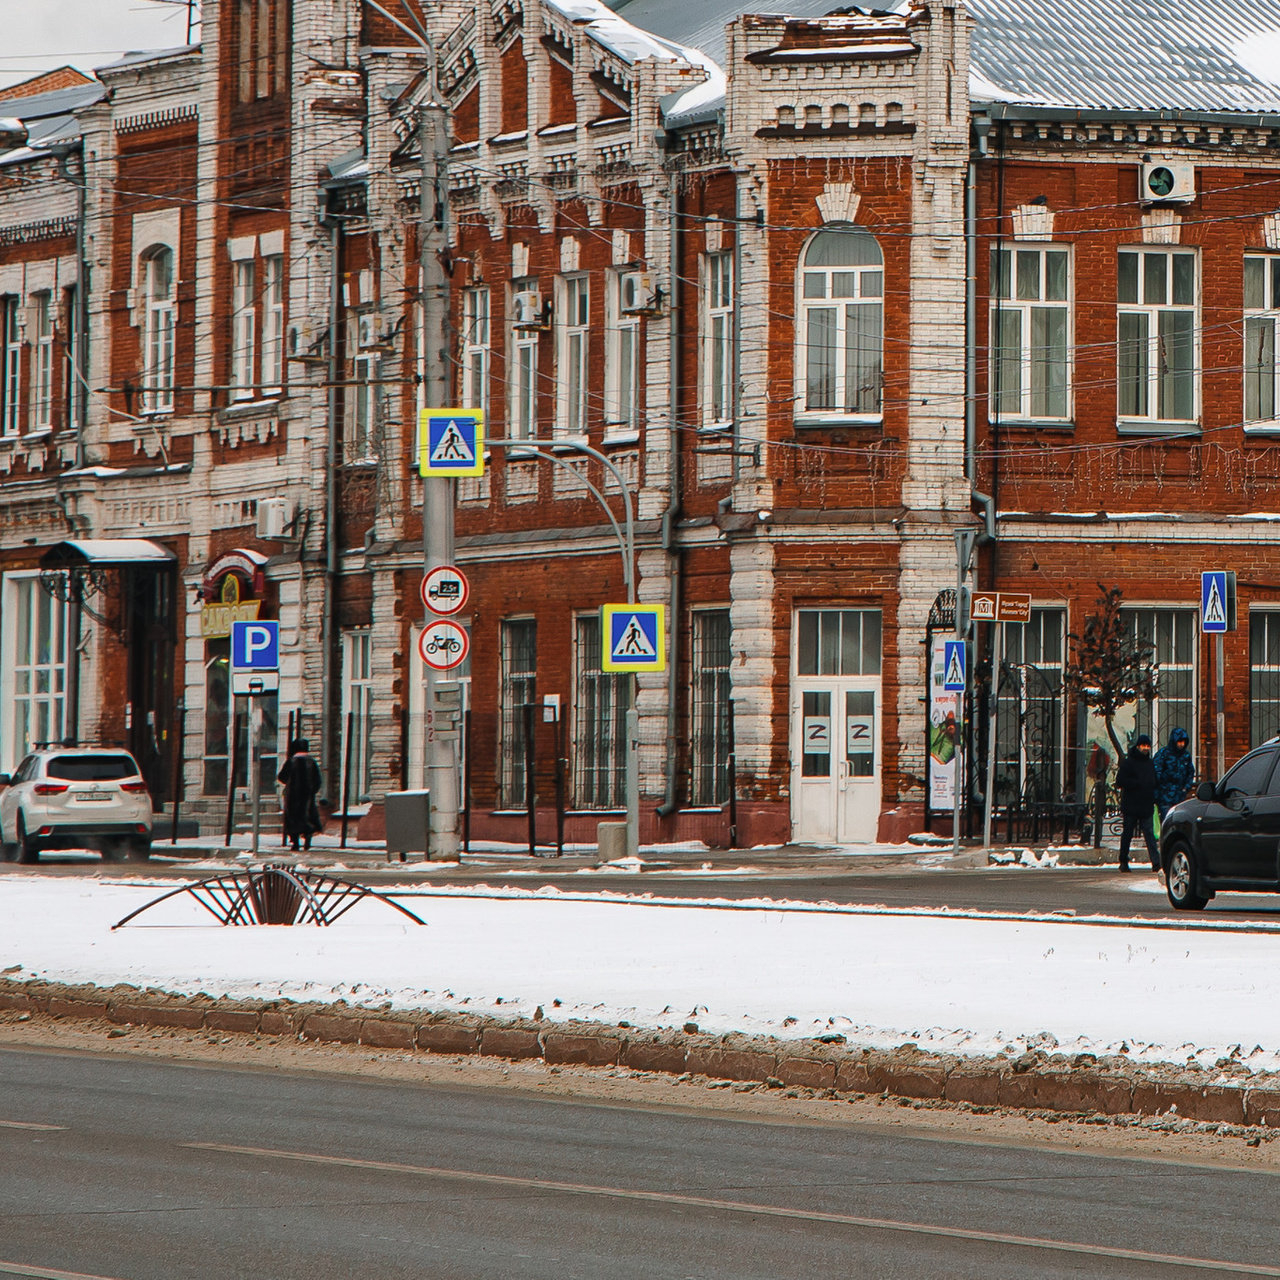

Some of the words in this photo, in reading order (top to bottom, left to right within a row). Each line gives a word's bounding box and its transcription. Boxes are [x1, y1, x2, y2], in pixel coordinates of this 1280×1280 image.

[245, 626, 272, 663] P
[808, 724, 827, 739] Z
[851, 724, 870, 739] Z
